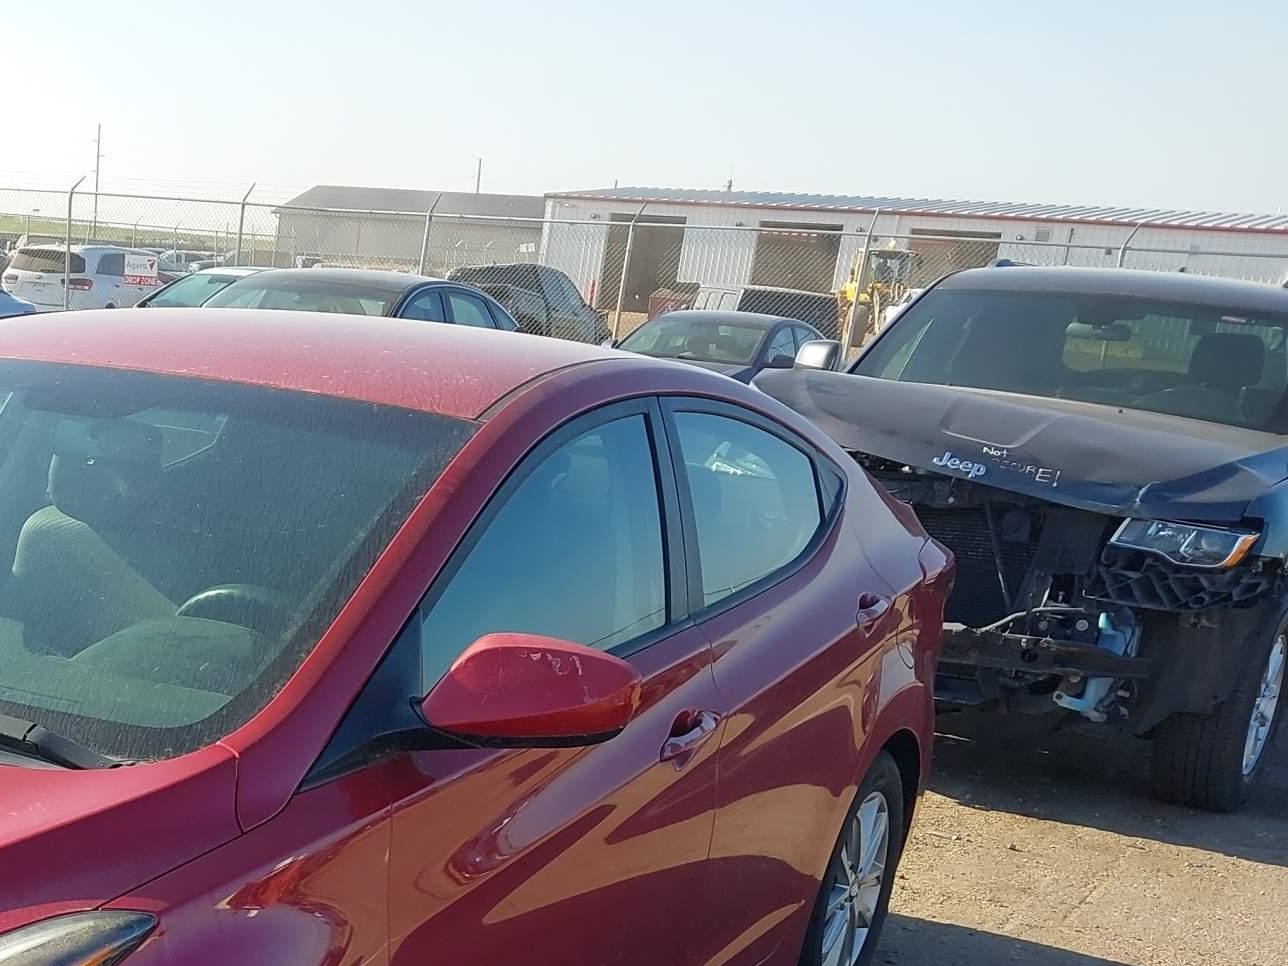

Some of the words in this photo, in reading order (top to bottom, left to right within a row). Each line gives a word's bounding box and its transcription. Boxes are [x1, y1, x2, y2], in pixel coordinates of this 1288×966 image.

[124, 275, 141, 285] DROP
[141, 275, 157, 286] ZONE
[932, 451, 987, 478] Jeep
